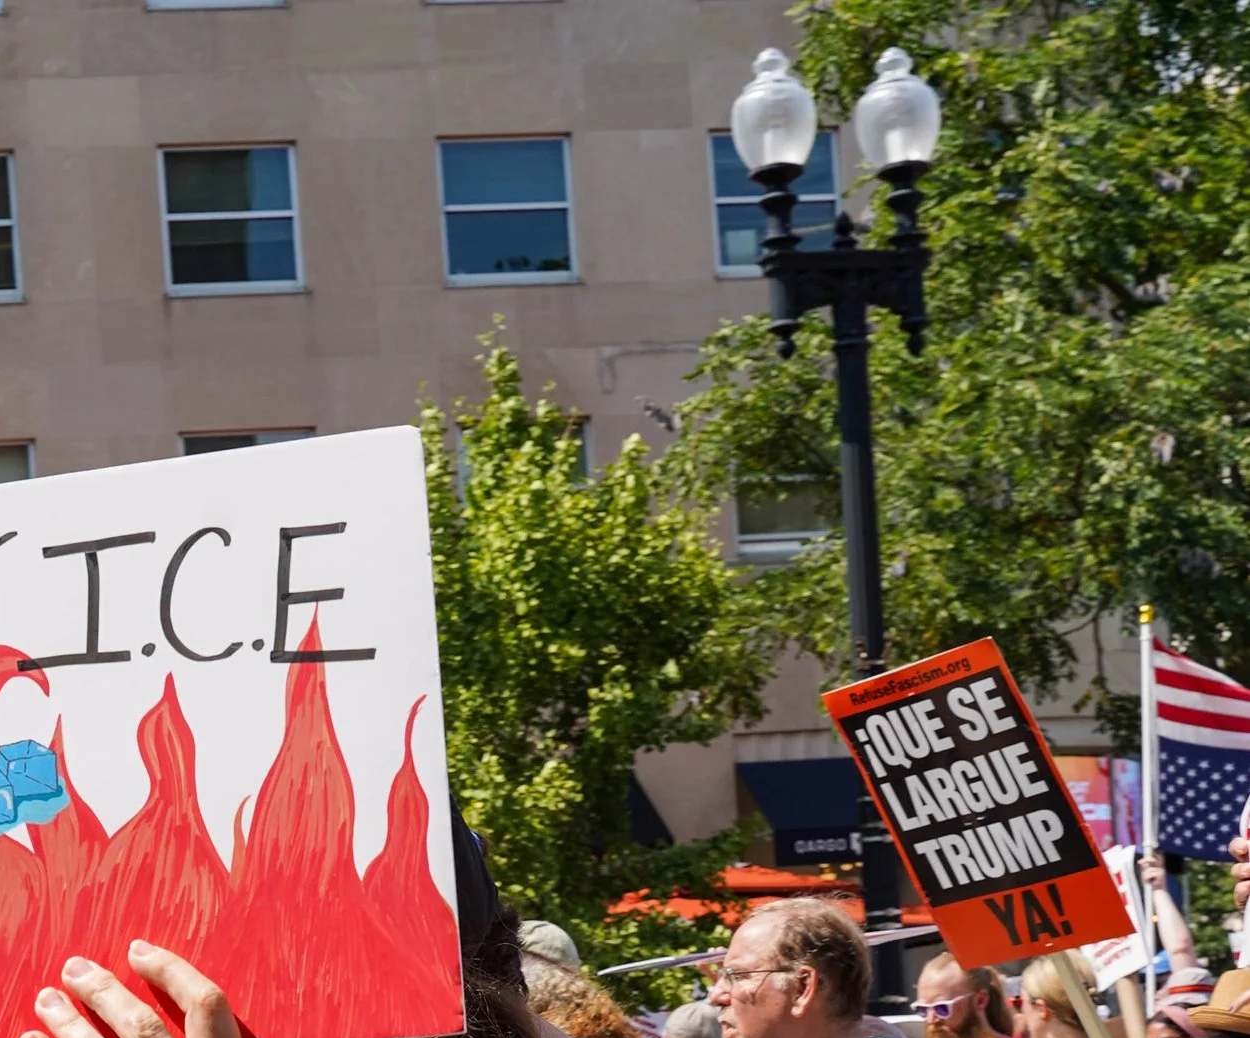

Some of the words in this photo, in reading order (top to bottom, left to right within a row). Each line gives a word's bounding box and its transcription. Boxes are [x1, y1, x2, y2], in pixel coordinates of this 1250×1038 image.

[18, 521, 377, 672] I.C.E
[849, 657, 972, 706] RefuseFascism.org
[855, 698, 956, 778] ¡QUE
[947, 677, 1018, 741] SE
[880, 741, 1049, 831] LARGUE
[914, 809, 1065, 890] TRUMP
[984, 883, 1073, 946] YA!
